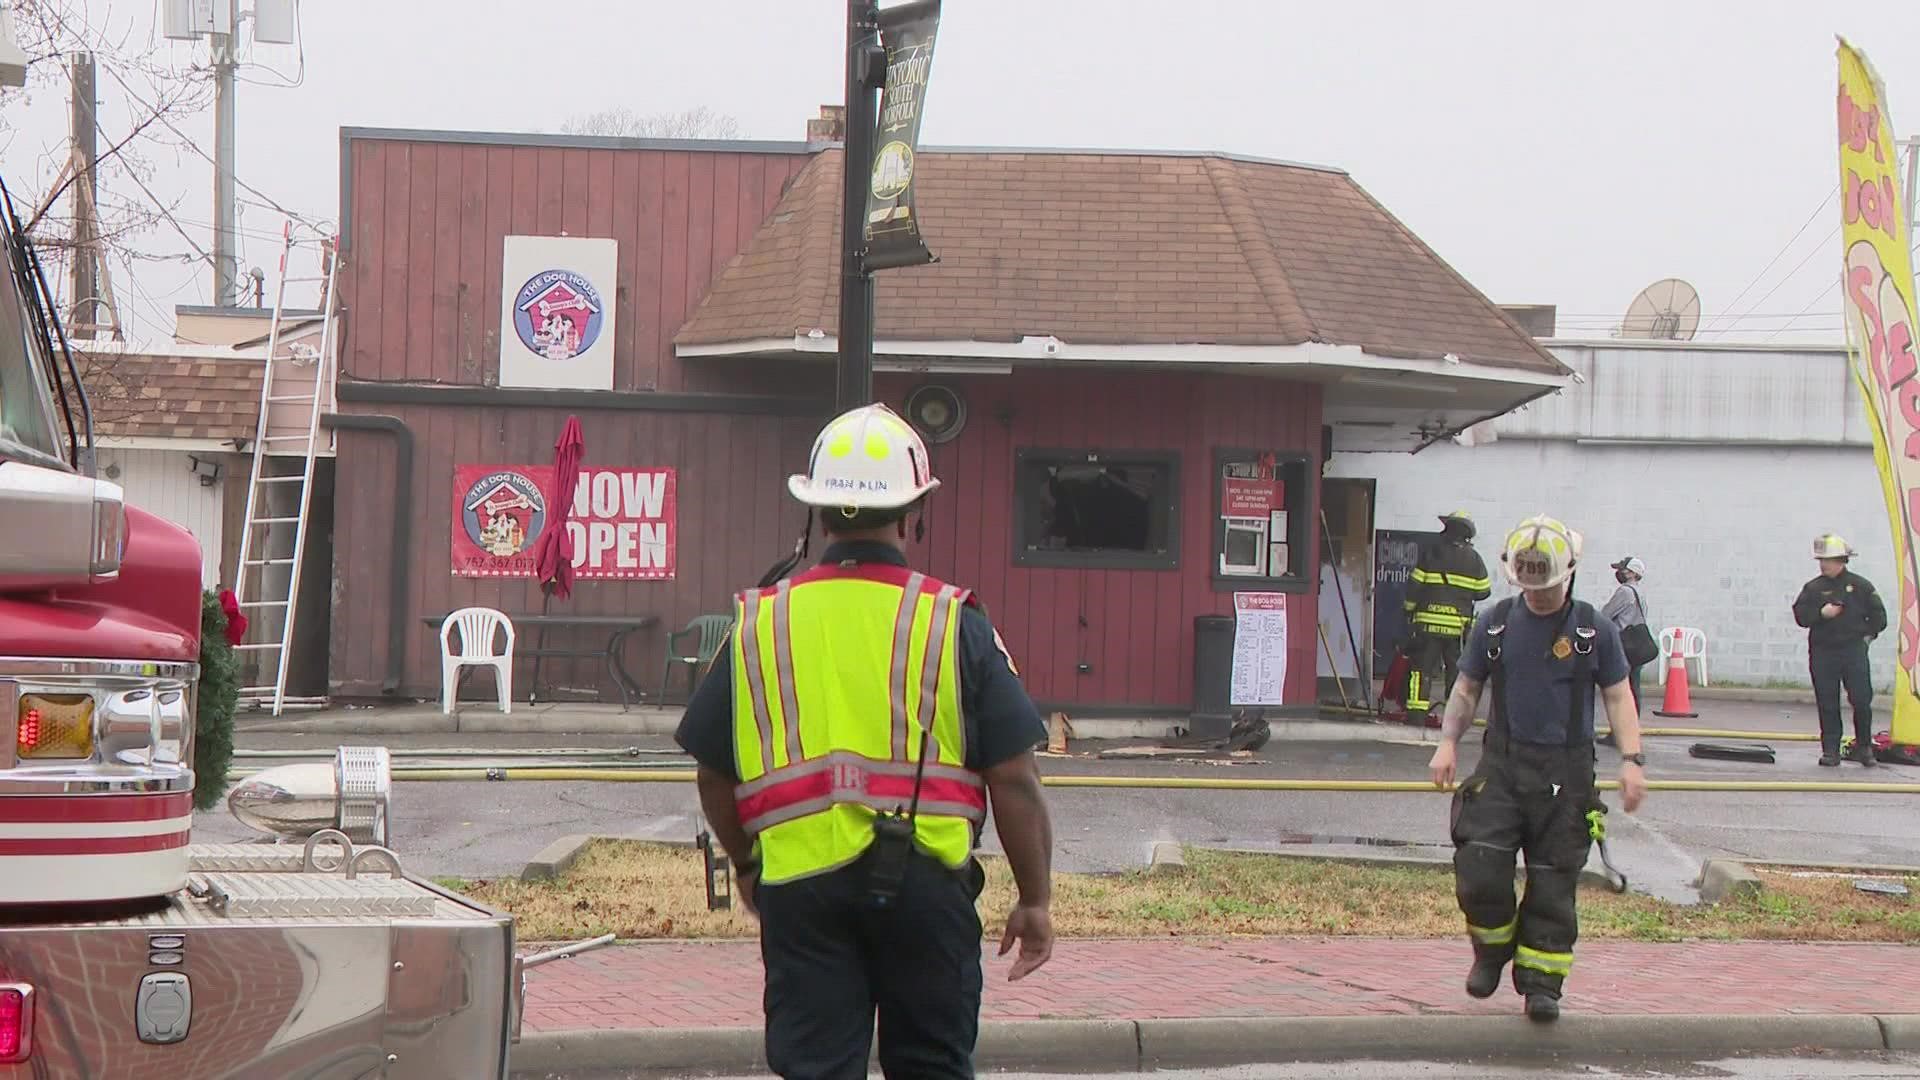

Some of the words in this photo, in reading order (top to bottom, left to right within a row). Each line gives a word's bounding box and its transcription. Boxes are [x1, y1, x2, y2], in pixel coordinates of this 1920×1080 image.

[523, 279, 543, 298] THE
[543, 273, 566, 284] DOG
[569, 274, 599, 302] HOUSE
[470, 481, 489, 498] THE
[488, 474, 510, 485] DOG
[512, 475, 542, 500] HOUSE
[567, 471, 667, 518] NOW
[566, 521, 667, 568] OPEN
